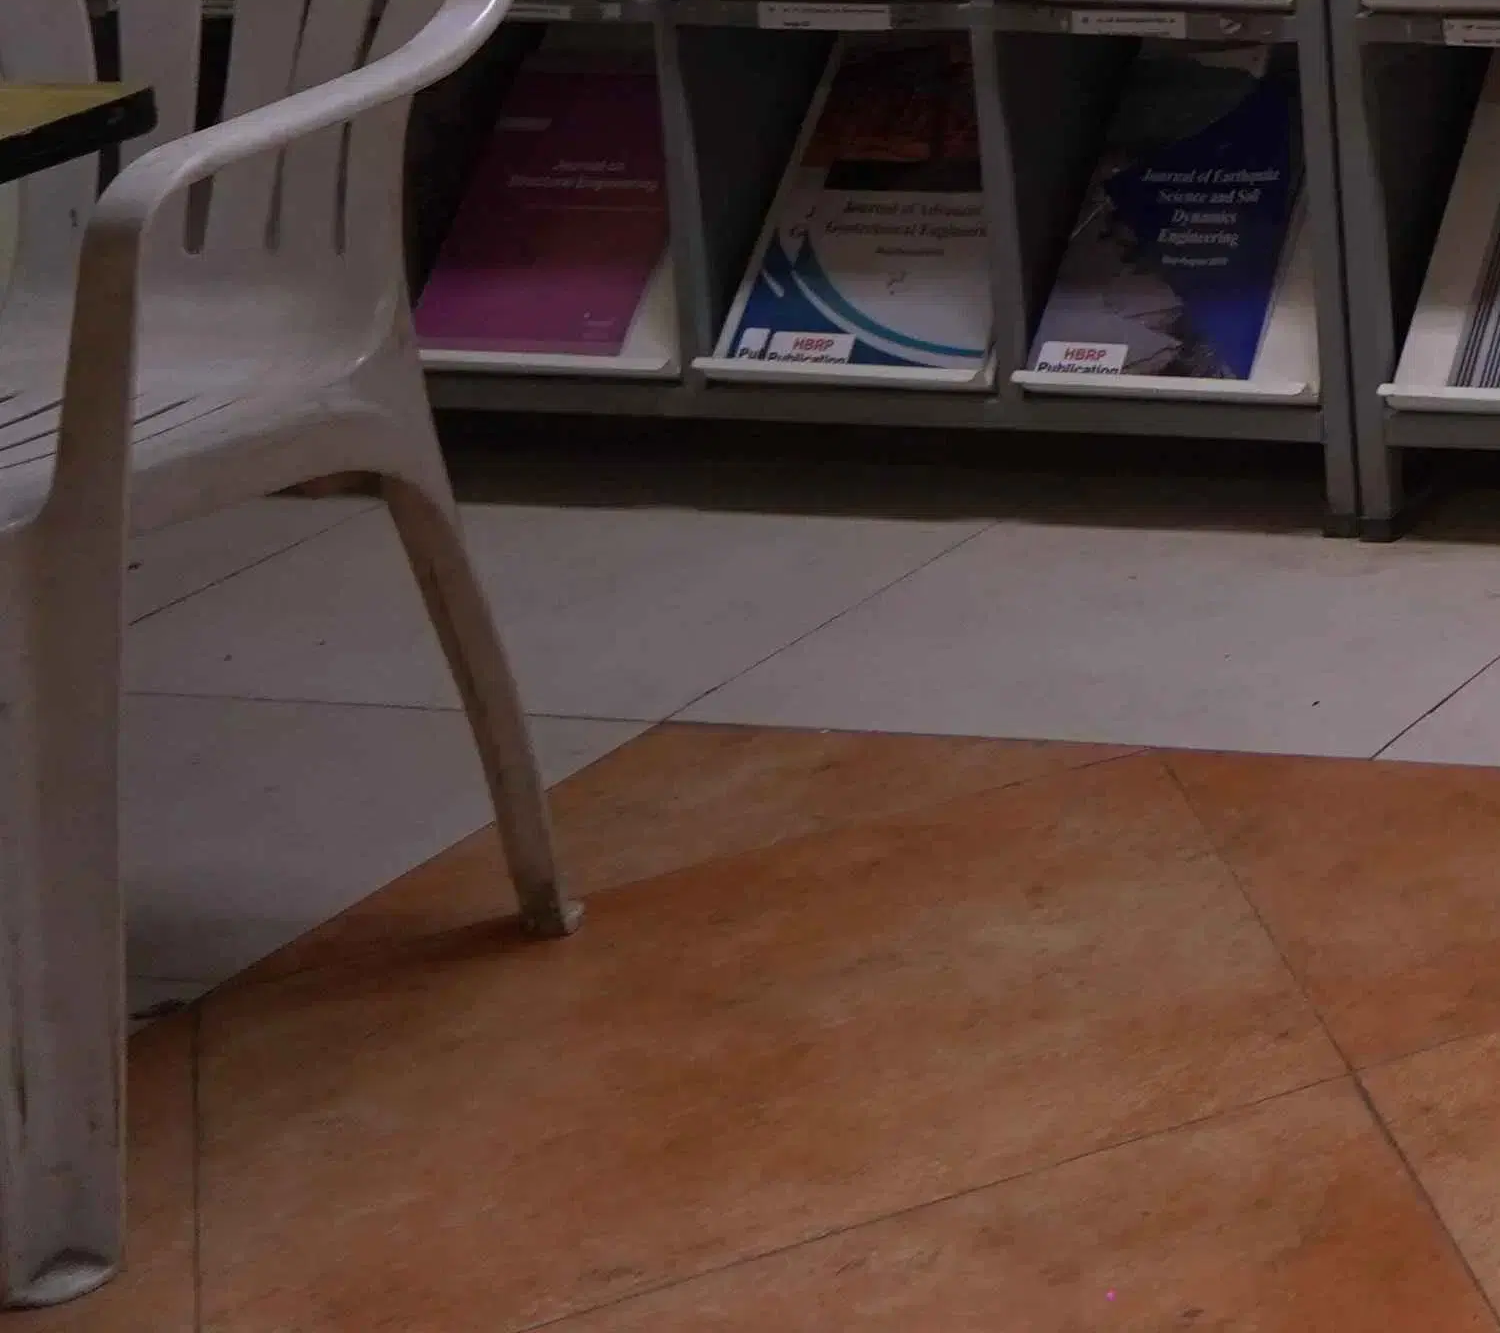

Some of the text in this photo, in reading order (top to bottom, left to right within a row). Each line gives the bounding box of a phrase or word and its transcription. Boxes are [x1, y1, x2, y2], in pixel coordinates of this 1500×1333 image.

[1140, 167, 1194, 184] Journal
[1196, 167, 1211, 184] of
[1155, 188, 1206, 205] Science
[1207, 189, 1235, 205] and
[1155, 229, 1242, 249] Engineering
[791, 337, 835, 351] HBRP
[1063, 347, 1107, 362] HBRP
